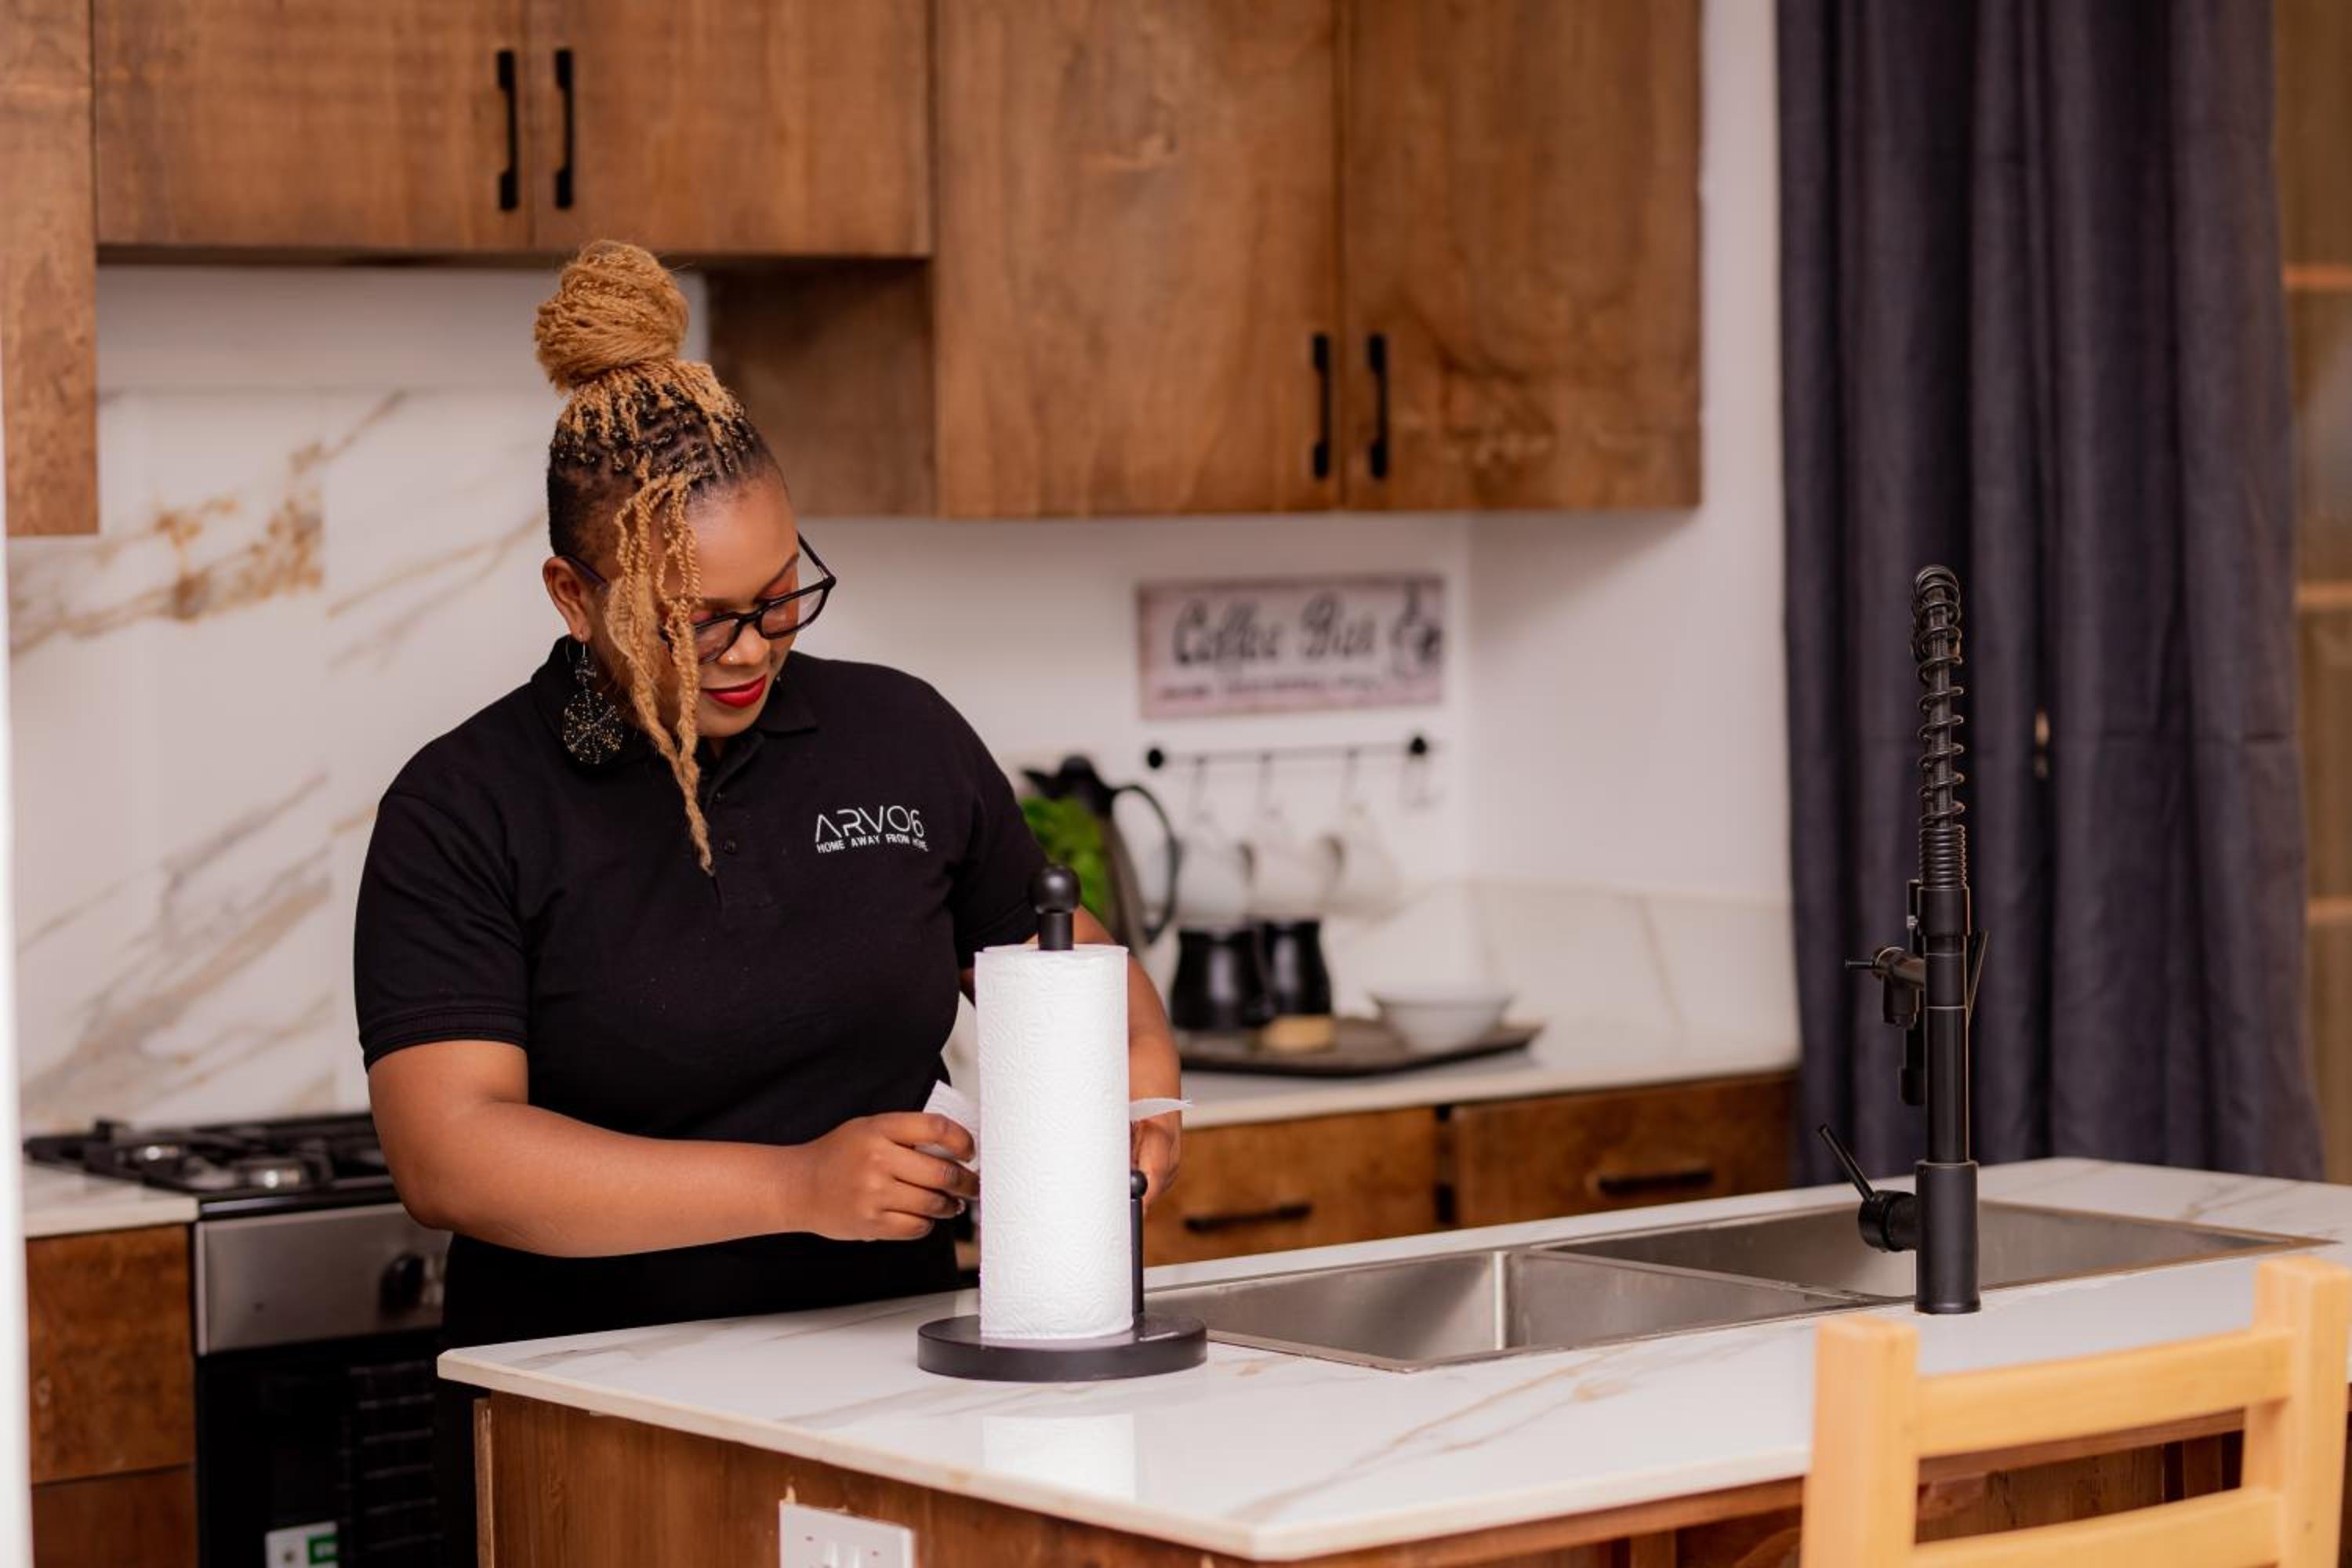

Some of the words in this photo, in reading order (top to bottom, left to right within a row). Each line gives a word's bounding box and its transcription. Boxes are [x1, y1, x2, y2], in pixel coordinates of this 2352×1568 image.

[816, 840, 845, 853] HOME
[851, 835, 880, 848] AWAY
[885, 833, 910, 844] FROM
